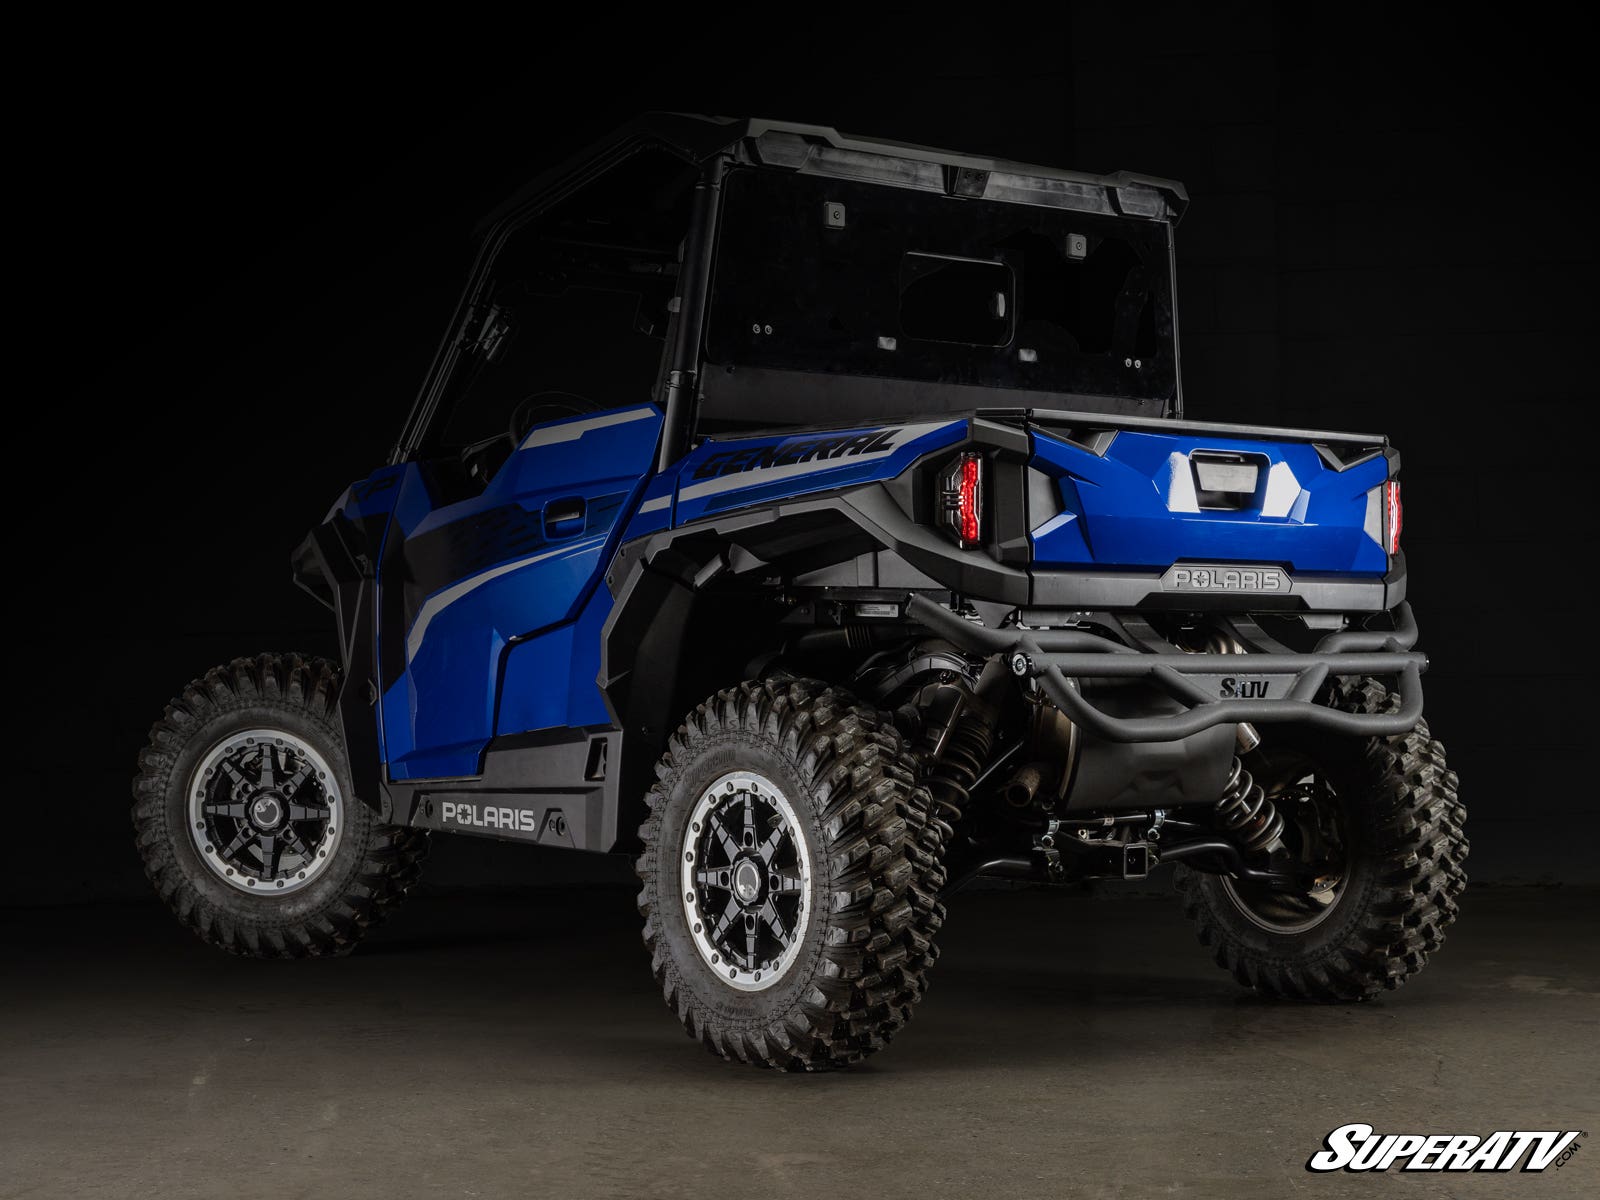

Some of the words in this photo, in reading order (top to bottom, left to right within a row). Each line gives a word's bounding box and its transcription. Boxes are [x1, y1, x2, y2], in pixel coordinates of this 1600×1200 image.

[692, 429, 903, 480] GENERAL
[1173, 569, 1280, 589] POLARIS
[442, 801, 535, 832] POLARIS
